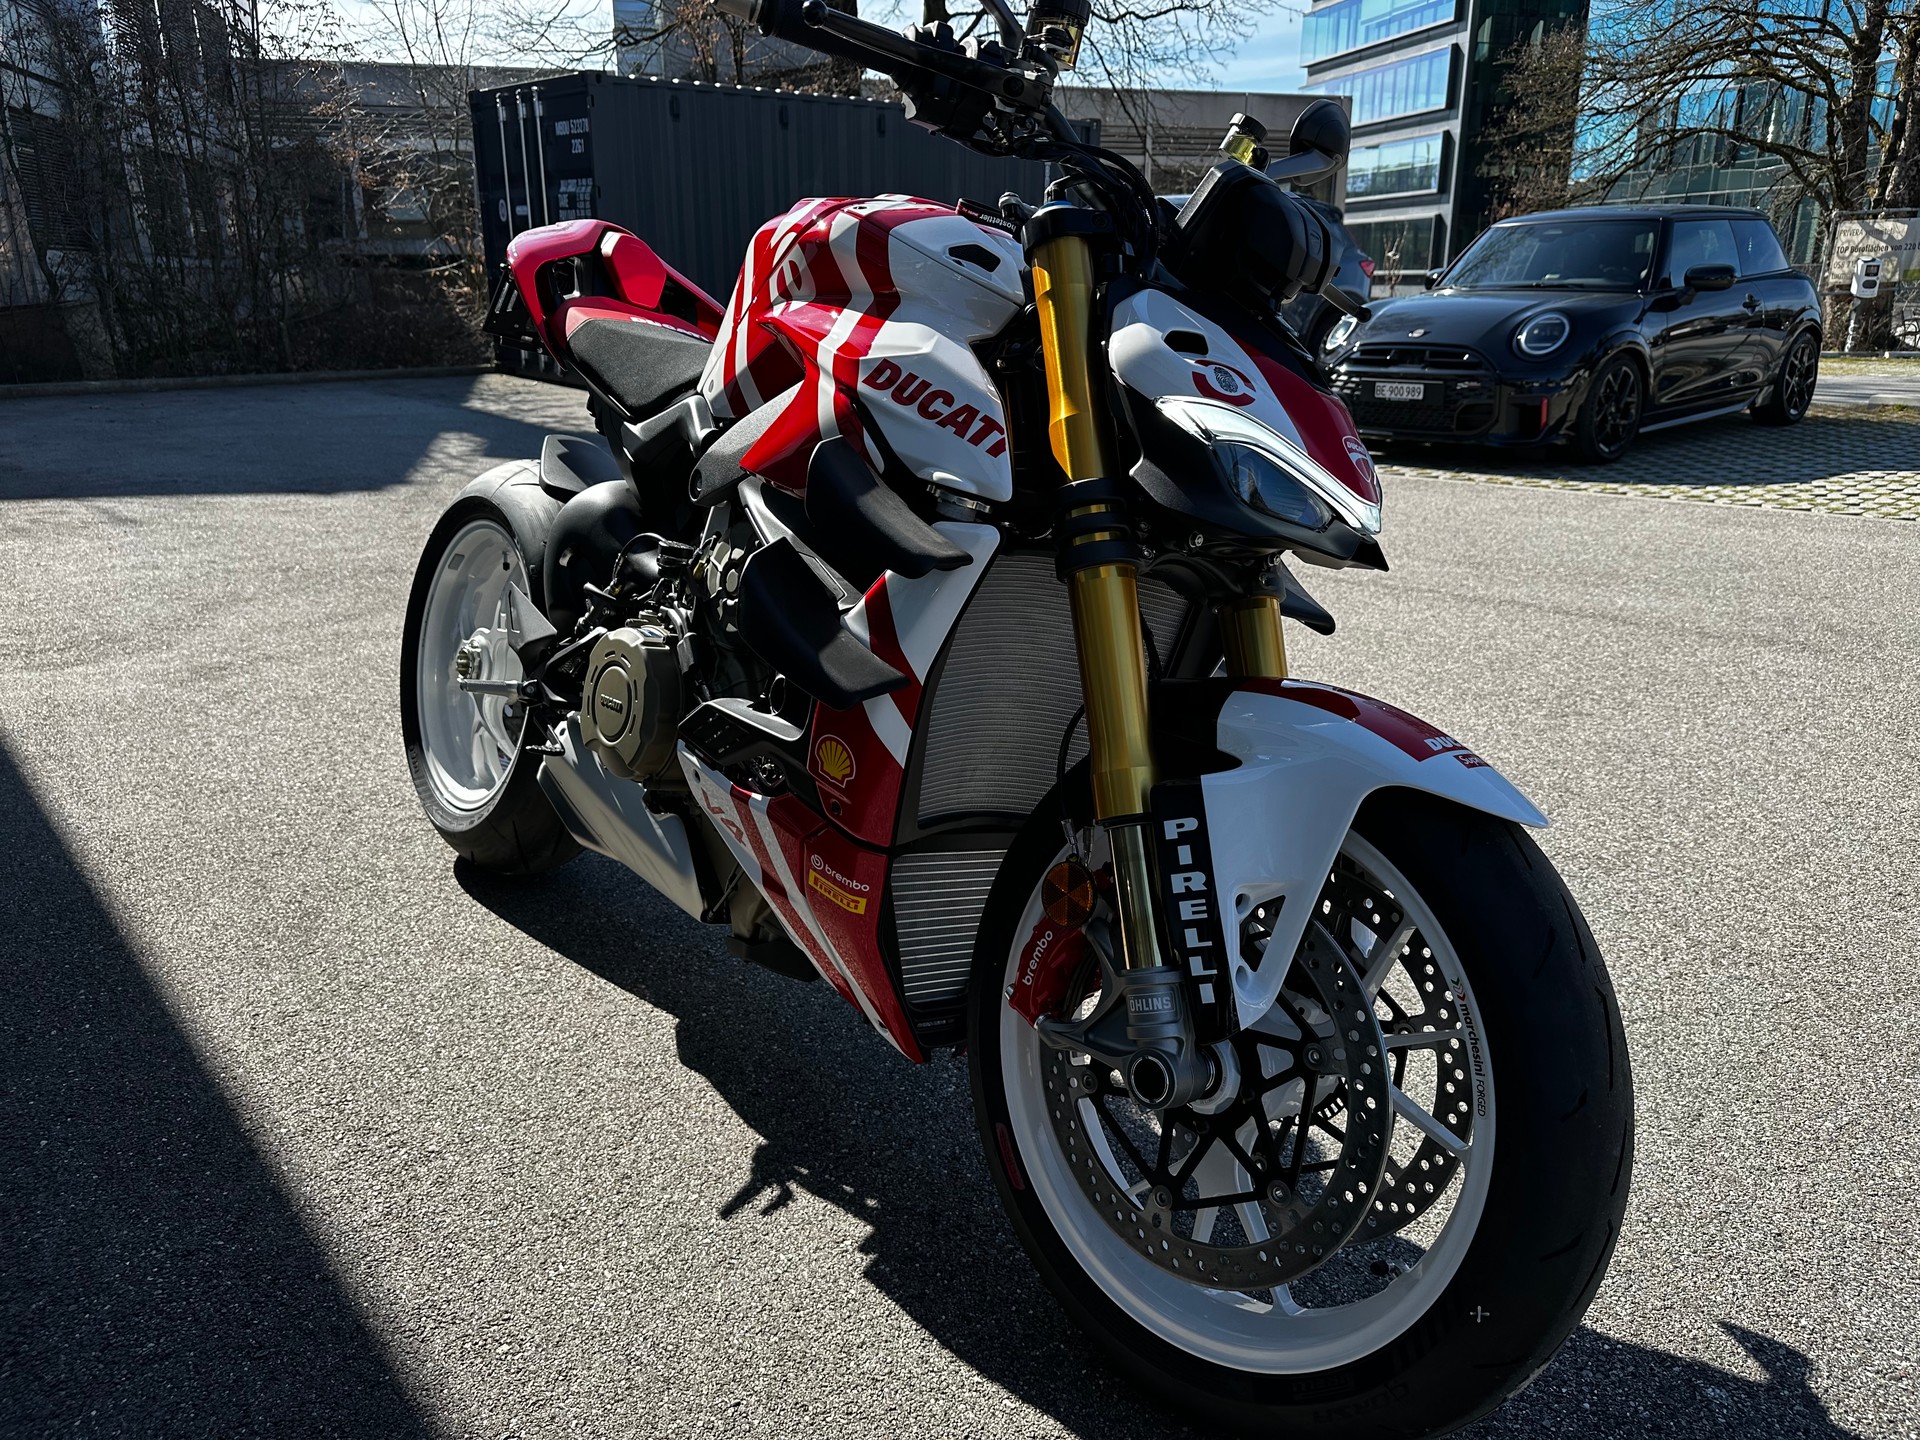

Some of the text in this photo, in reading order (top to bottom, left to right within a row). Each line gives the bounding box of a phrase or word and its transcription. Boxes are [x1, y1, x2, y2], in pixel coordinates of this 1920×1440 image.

[1836, 245, 1850, 255] TOP
[1890, 244, 1903, 252] von
[1904, 242, 1917, 251] 220
[861, 358, 1007, 459] DUCATI
[825, 864, 870, 892] brembo
[1163, 817, 1218, 1005] PIRELLI
[1022, 930, 1054, 987] brembo
[1129, 996, 1172, 1012] ÖHLINS
[1459, 1003, 1486, 1117] marchesini FORGED
